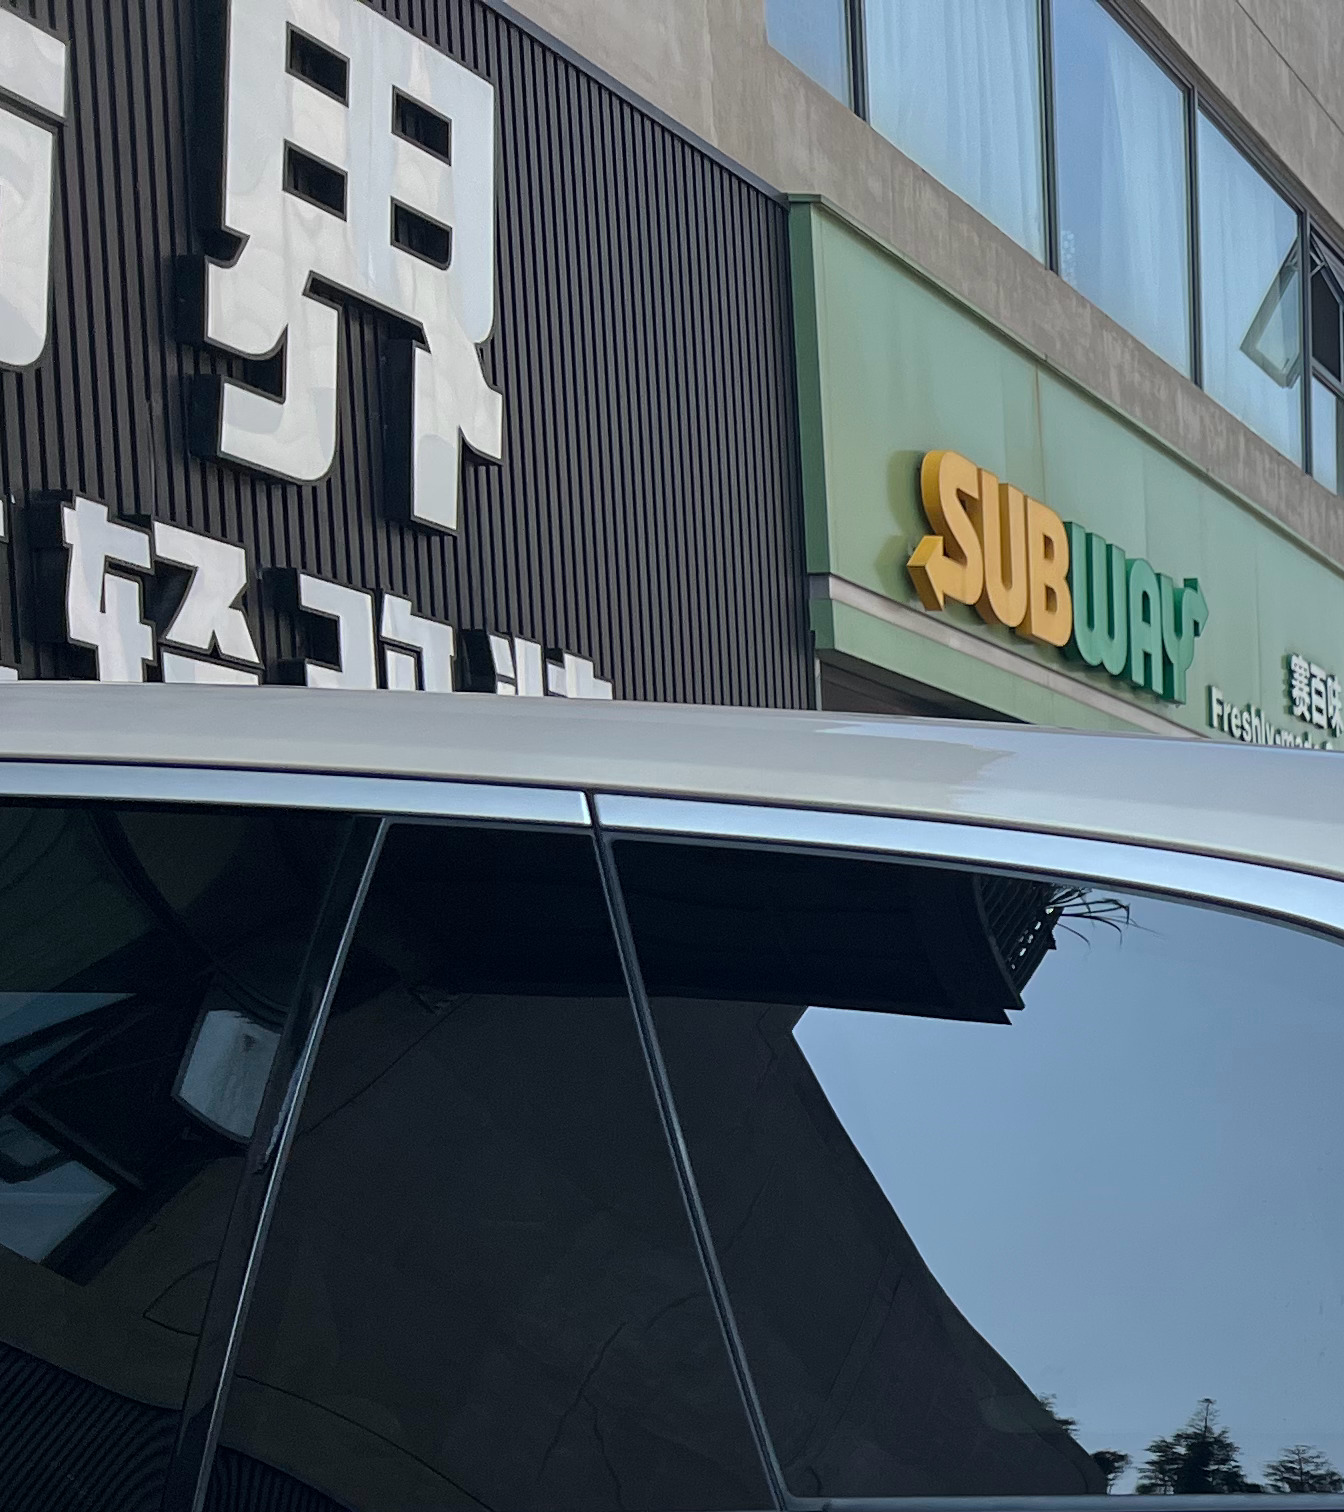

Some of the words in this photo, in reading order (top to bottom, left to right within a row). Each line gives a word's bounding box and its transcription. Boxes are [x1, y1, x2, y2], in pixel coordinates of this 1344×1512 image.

[0, 0, 503, 534] 界
[907, 449, 1209, 704] SUBWAY
[1211, 685, 1322, 750] Freshly-m
[1291, 654, 1344, 738] 赛百味
